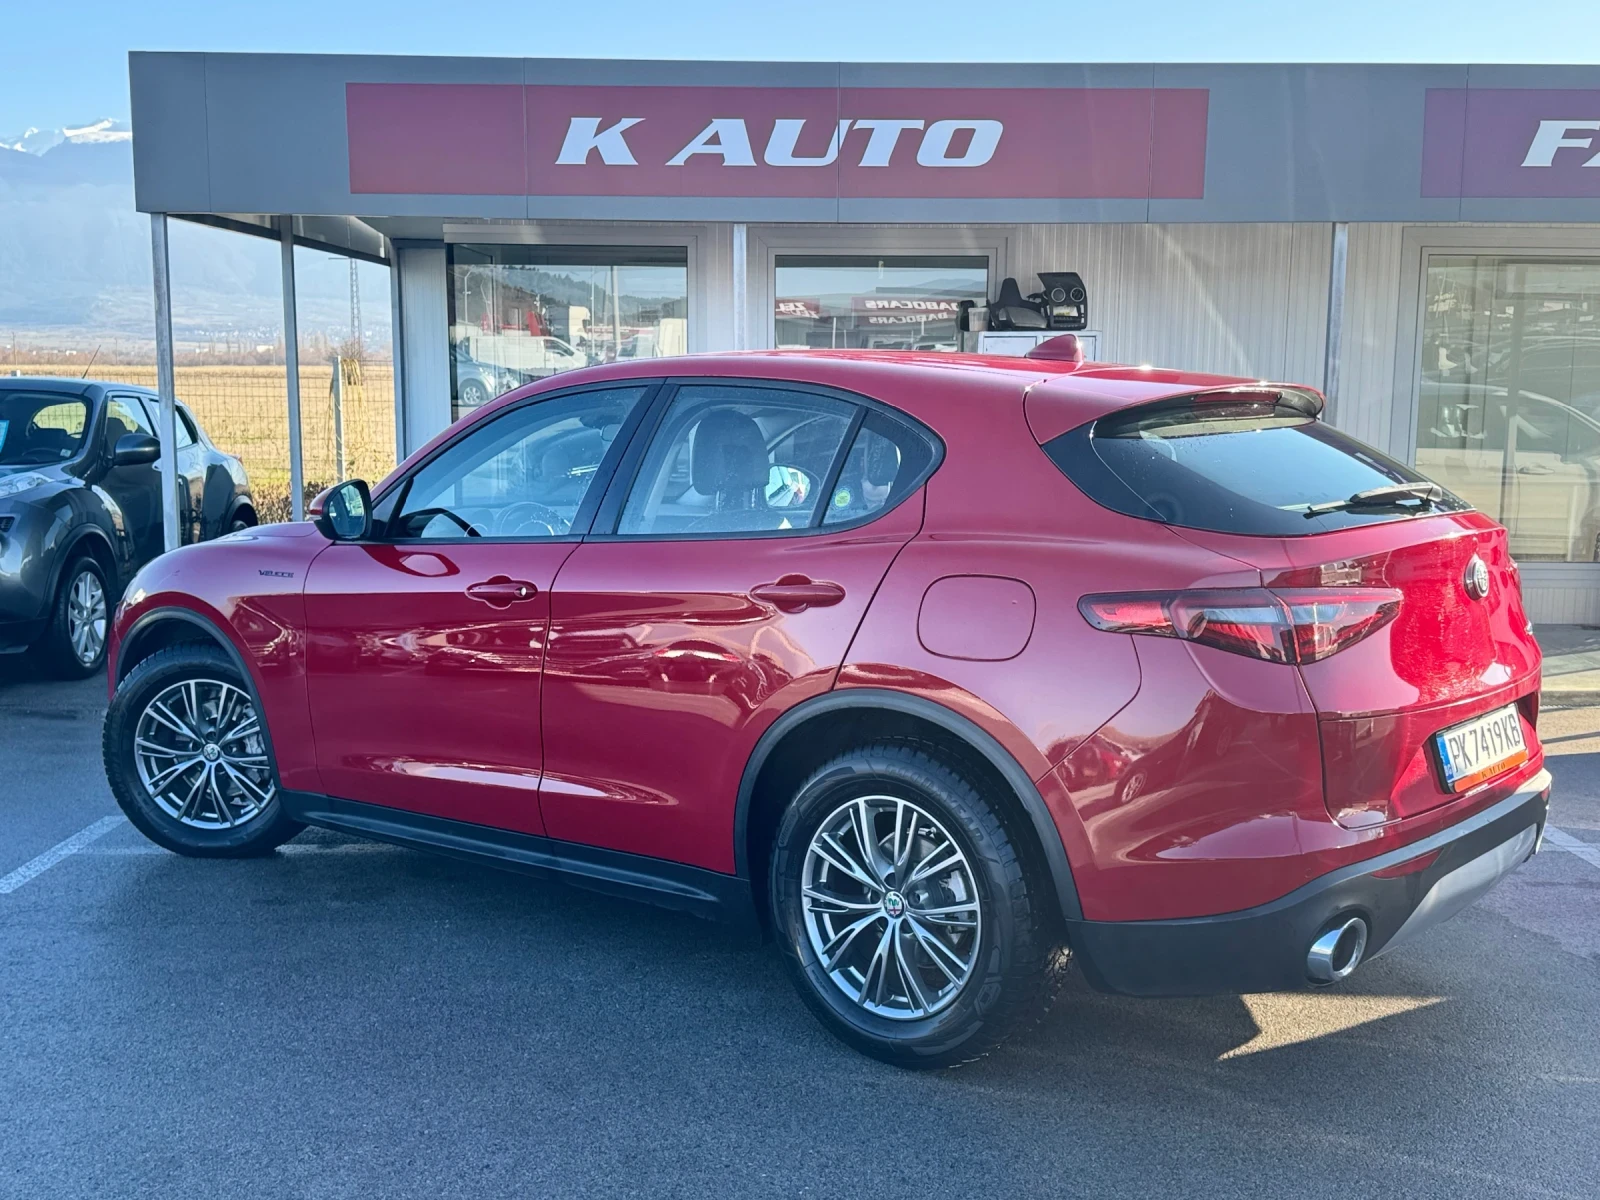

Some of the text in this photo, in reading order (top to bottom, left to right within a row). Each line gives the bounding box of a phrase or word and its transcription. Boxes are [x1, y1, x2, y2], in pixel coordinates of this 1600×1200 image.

[555, 117, 1004, 167] K AUTO
[1520, 120, 1600, 167] F
